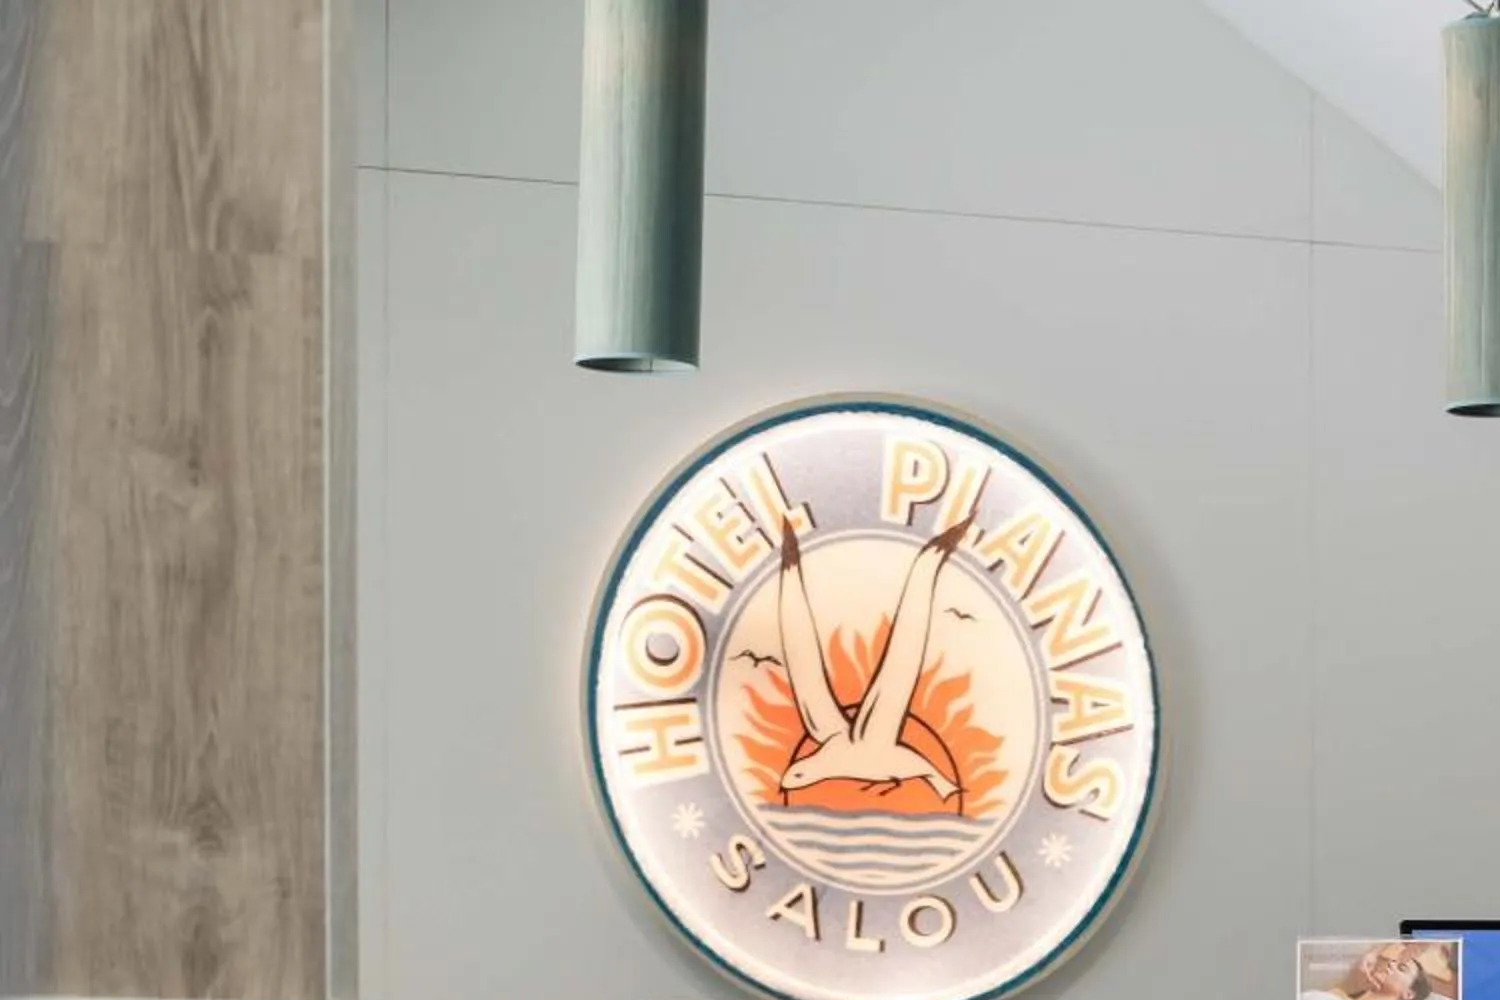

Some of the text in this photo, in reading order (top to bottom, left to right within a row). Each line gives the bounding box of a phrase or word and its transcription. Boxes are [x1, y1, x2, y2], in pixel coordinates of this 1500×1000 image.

[615, 436, 1133, 821] HOTEL PLANAS
[708, 833, 1025, 953] SALOU
